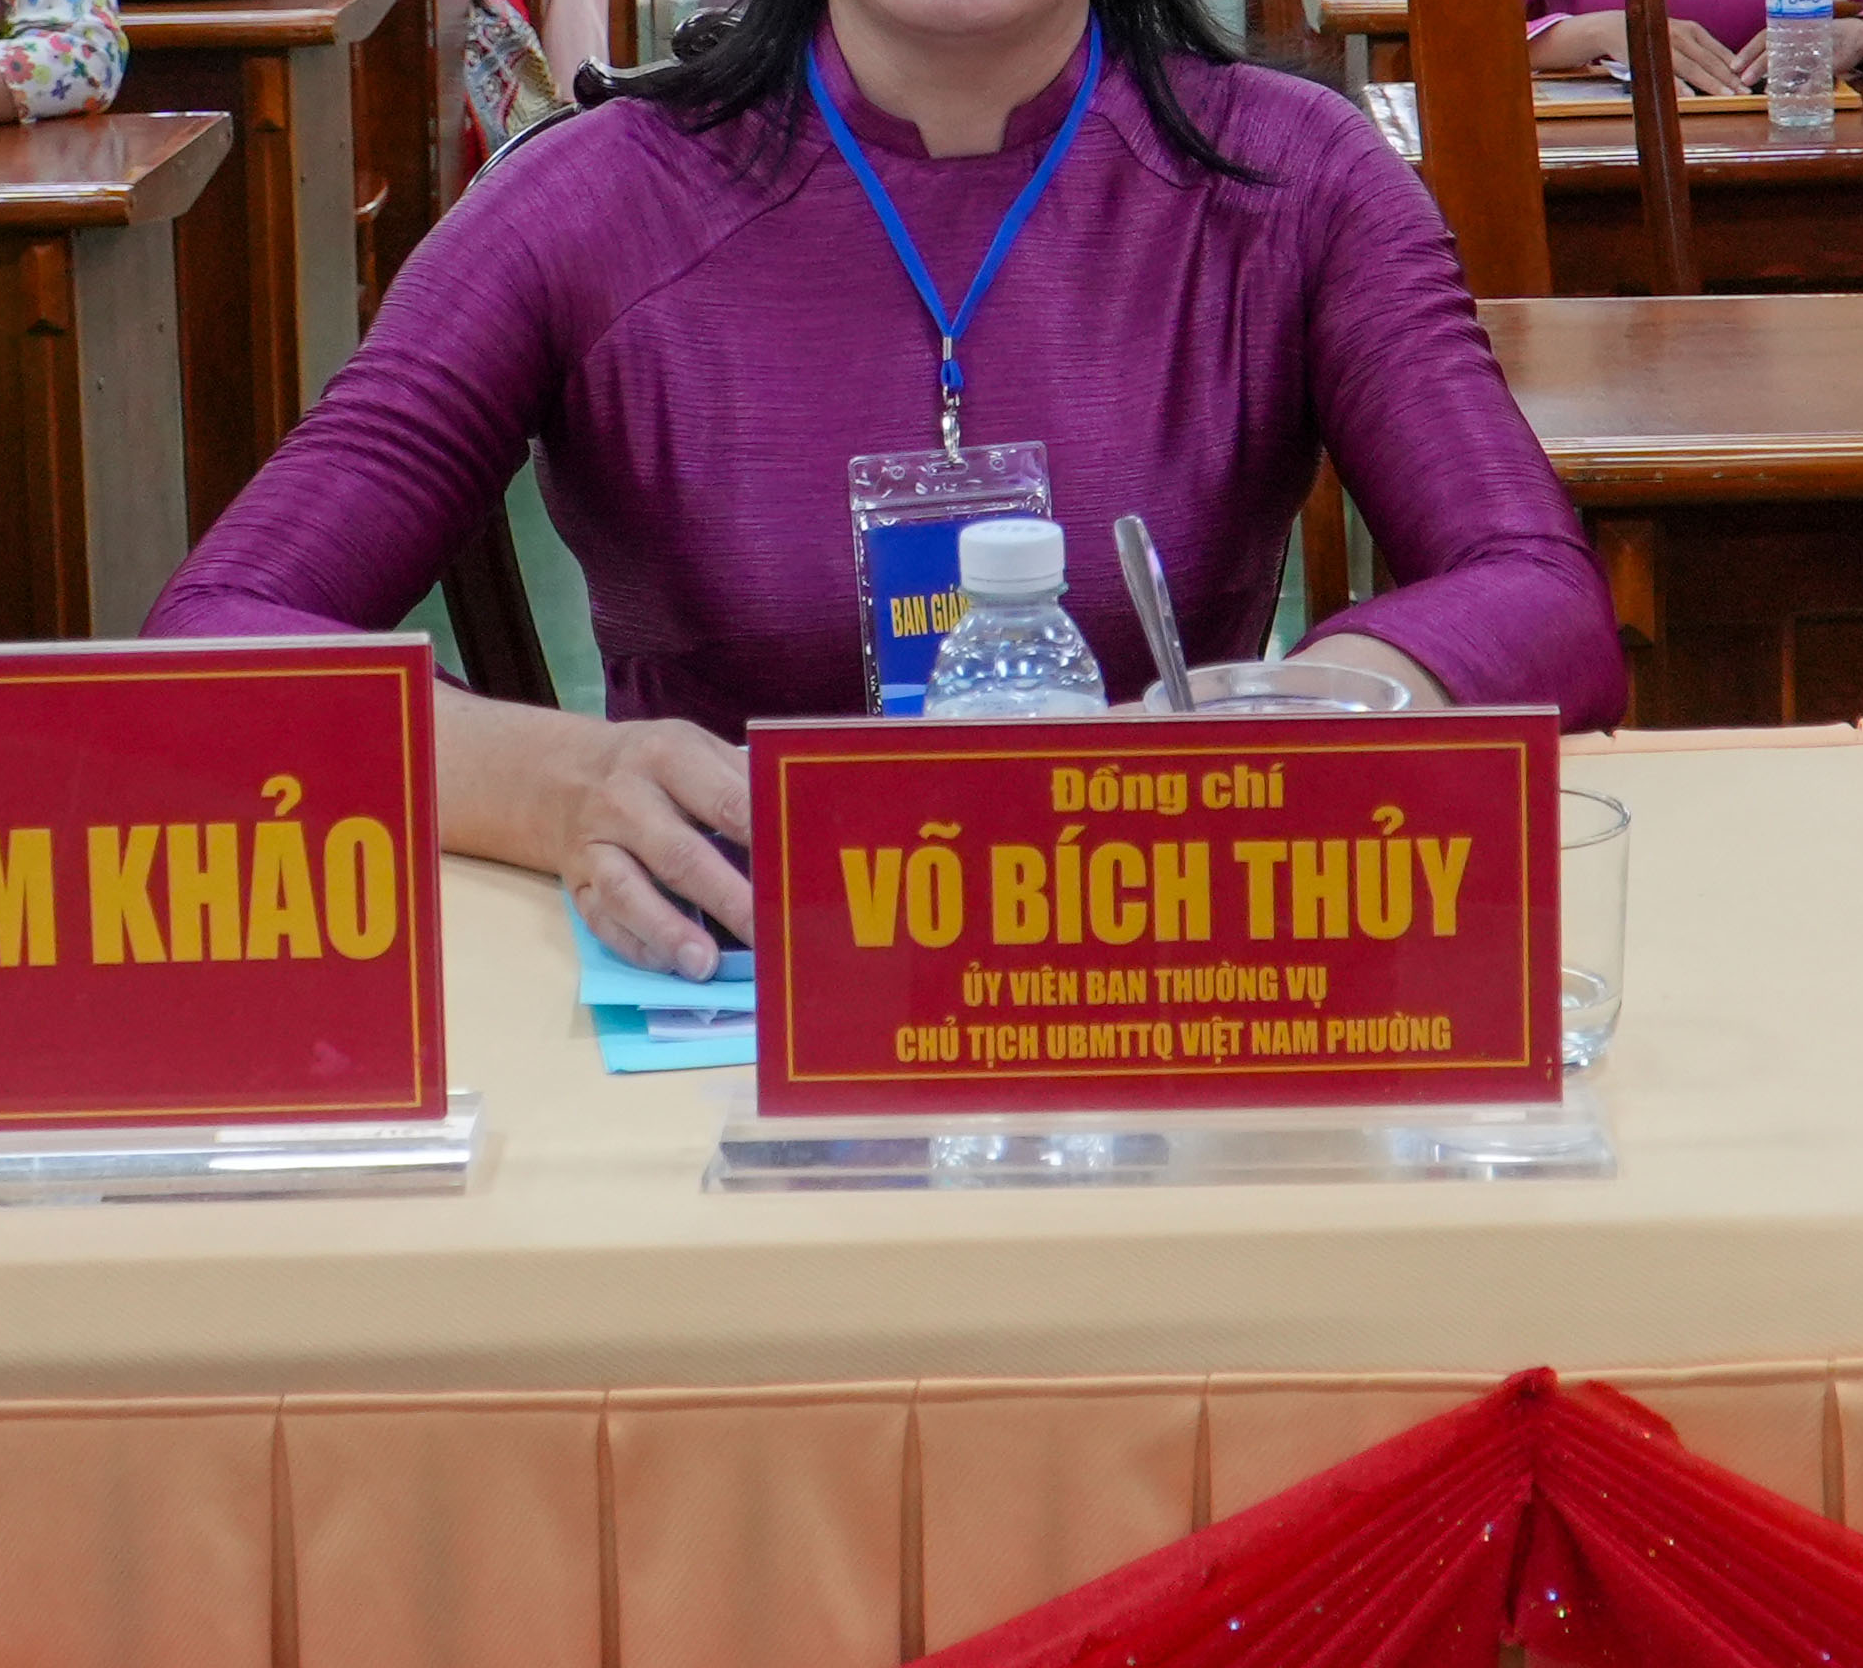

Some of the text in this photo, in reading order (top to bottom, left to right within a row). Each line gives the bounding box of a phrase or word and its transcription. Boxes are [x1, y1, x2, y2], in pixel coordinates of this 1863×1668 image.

[890, 583, 972, 638] BAN GIÁ
[1051, 763, 1283, 815] Đồng chí
[87, 775, 397, 965] KHẢO
[840, 805, 1472, 948] VÕ BÍCH THỦY
[963, 961, 1327, 1008] ỦY VIÊN BAN THƯỜNG VỤ
[896, 1011, 1452, 1068] CHỦ TỊCH UBMTTQ VIỆT NAM PHƯỜNG
